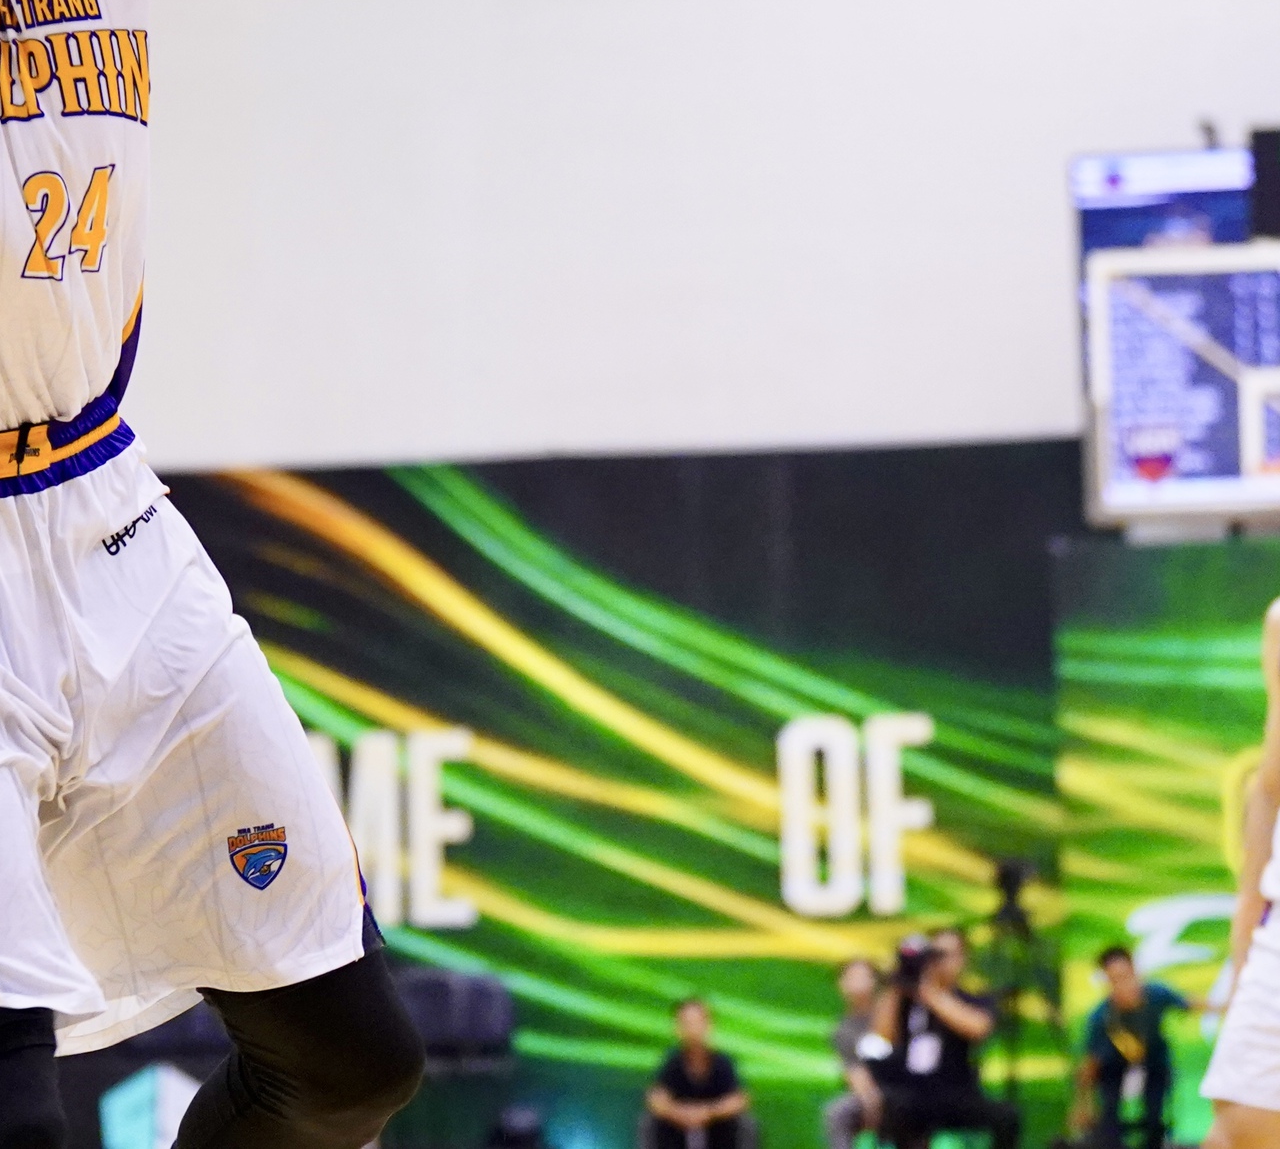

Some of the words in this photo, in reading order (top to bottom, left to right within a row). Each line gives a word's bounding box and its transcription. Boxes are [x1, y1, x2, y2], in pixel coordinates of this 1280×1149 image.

[21, 164, 116, 281] 24
[227, 826, 287, 854] DOLPHINS
[777, 712, 935, 917] OF
